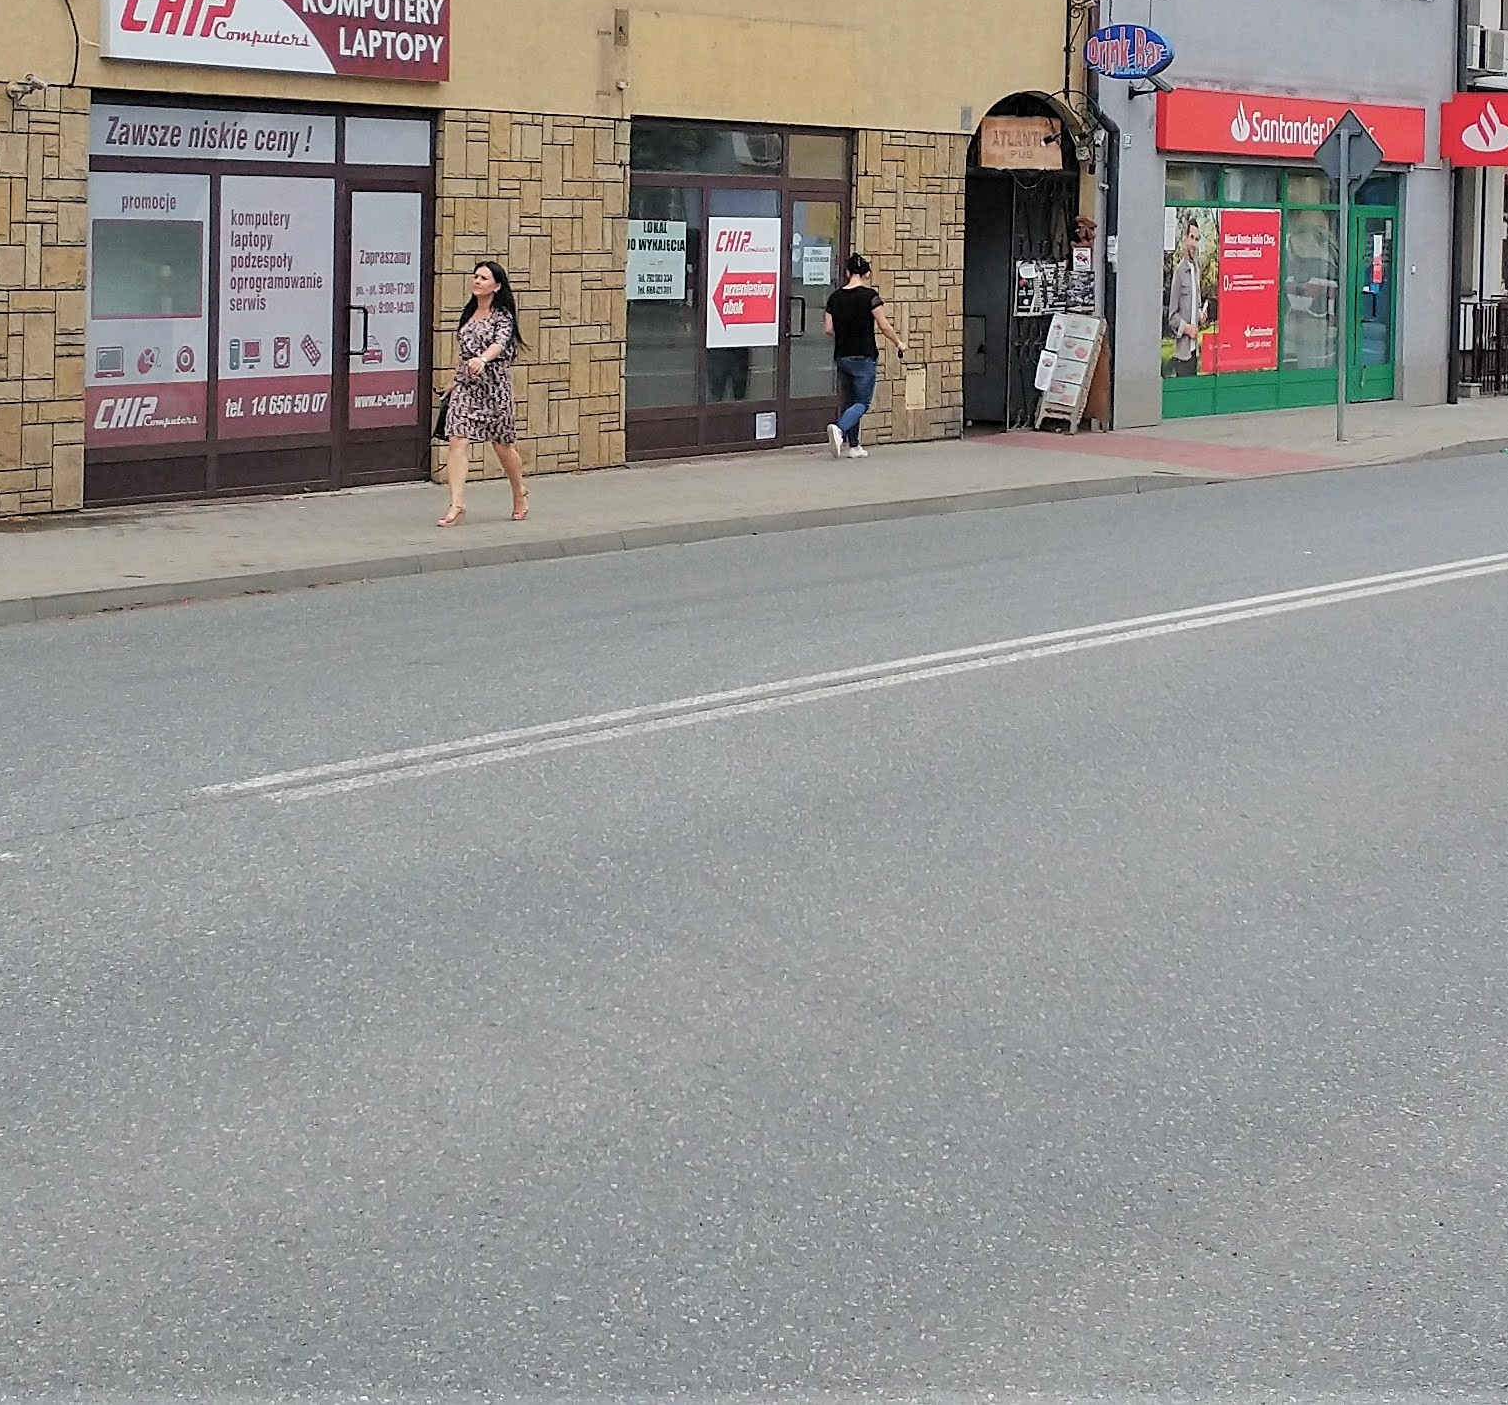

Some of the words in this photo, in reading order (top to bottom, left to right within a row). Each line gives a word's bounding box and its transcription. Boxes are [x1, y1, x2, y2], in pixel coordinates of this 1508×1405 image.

[214, 21, 311, 48] Computers
[339, 26, 444, 64] LAPTOPY
[1087, 27, 1131, 72] Drink
[1135, 28, 1164, 69] Bar
[105, 115, 182, 148] Zawsze
[189, 119, 248, 150] niskie
[254, 127, 299, 158] ceny
[992, 129, 1048, 147] ATLANTI
[1252, 111, 1324, 145] Santander
[1010, 150, 1034, 160] PUB
[121, 194, 177, 212] promocje
[230, 209, 290, 230] komputery
[643, 221, 667, 233] LOKAL
[230, 231, 273, 251] laptopy
[715, 231, 752, 251] CHIP
[230, 251, 293, 272] podzespoły
[359, 249, 411, 266] Zapraszamy
[230, 273, 323, 293] oprogramowanie
[229, 295, 266, 312] serwis
[723, 299, 744, 314] obok
[225, 400, 244, 418] tel.
[252, 398, 268, 416] 14
[269, 397, 292, 415] 656
[293, 395, 310, 414] 50
[311, 394, 328, 413] 07
[354, 390, 414, 409] www.e-chip.pl
[93, 396, 159, 430] CHIP
[143, 415, 198, 429] Computers
